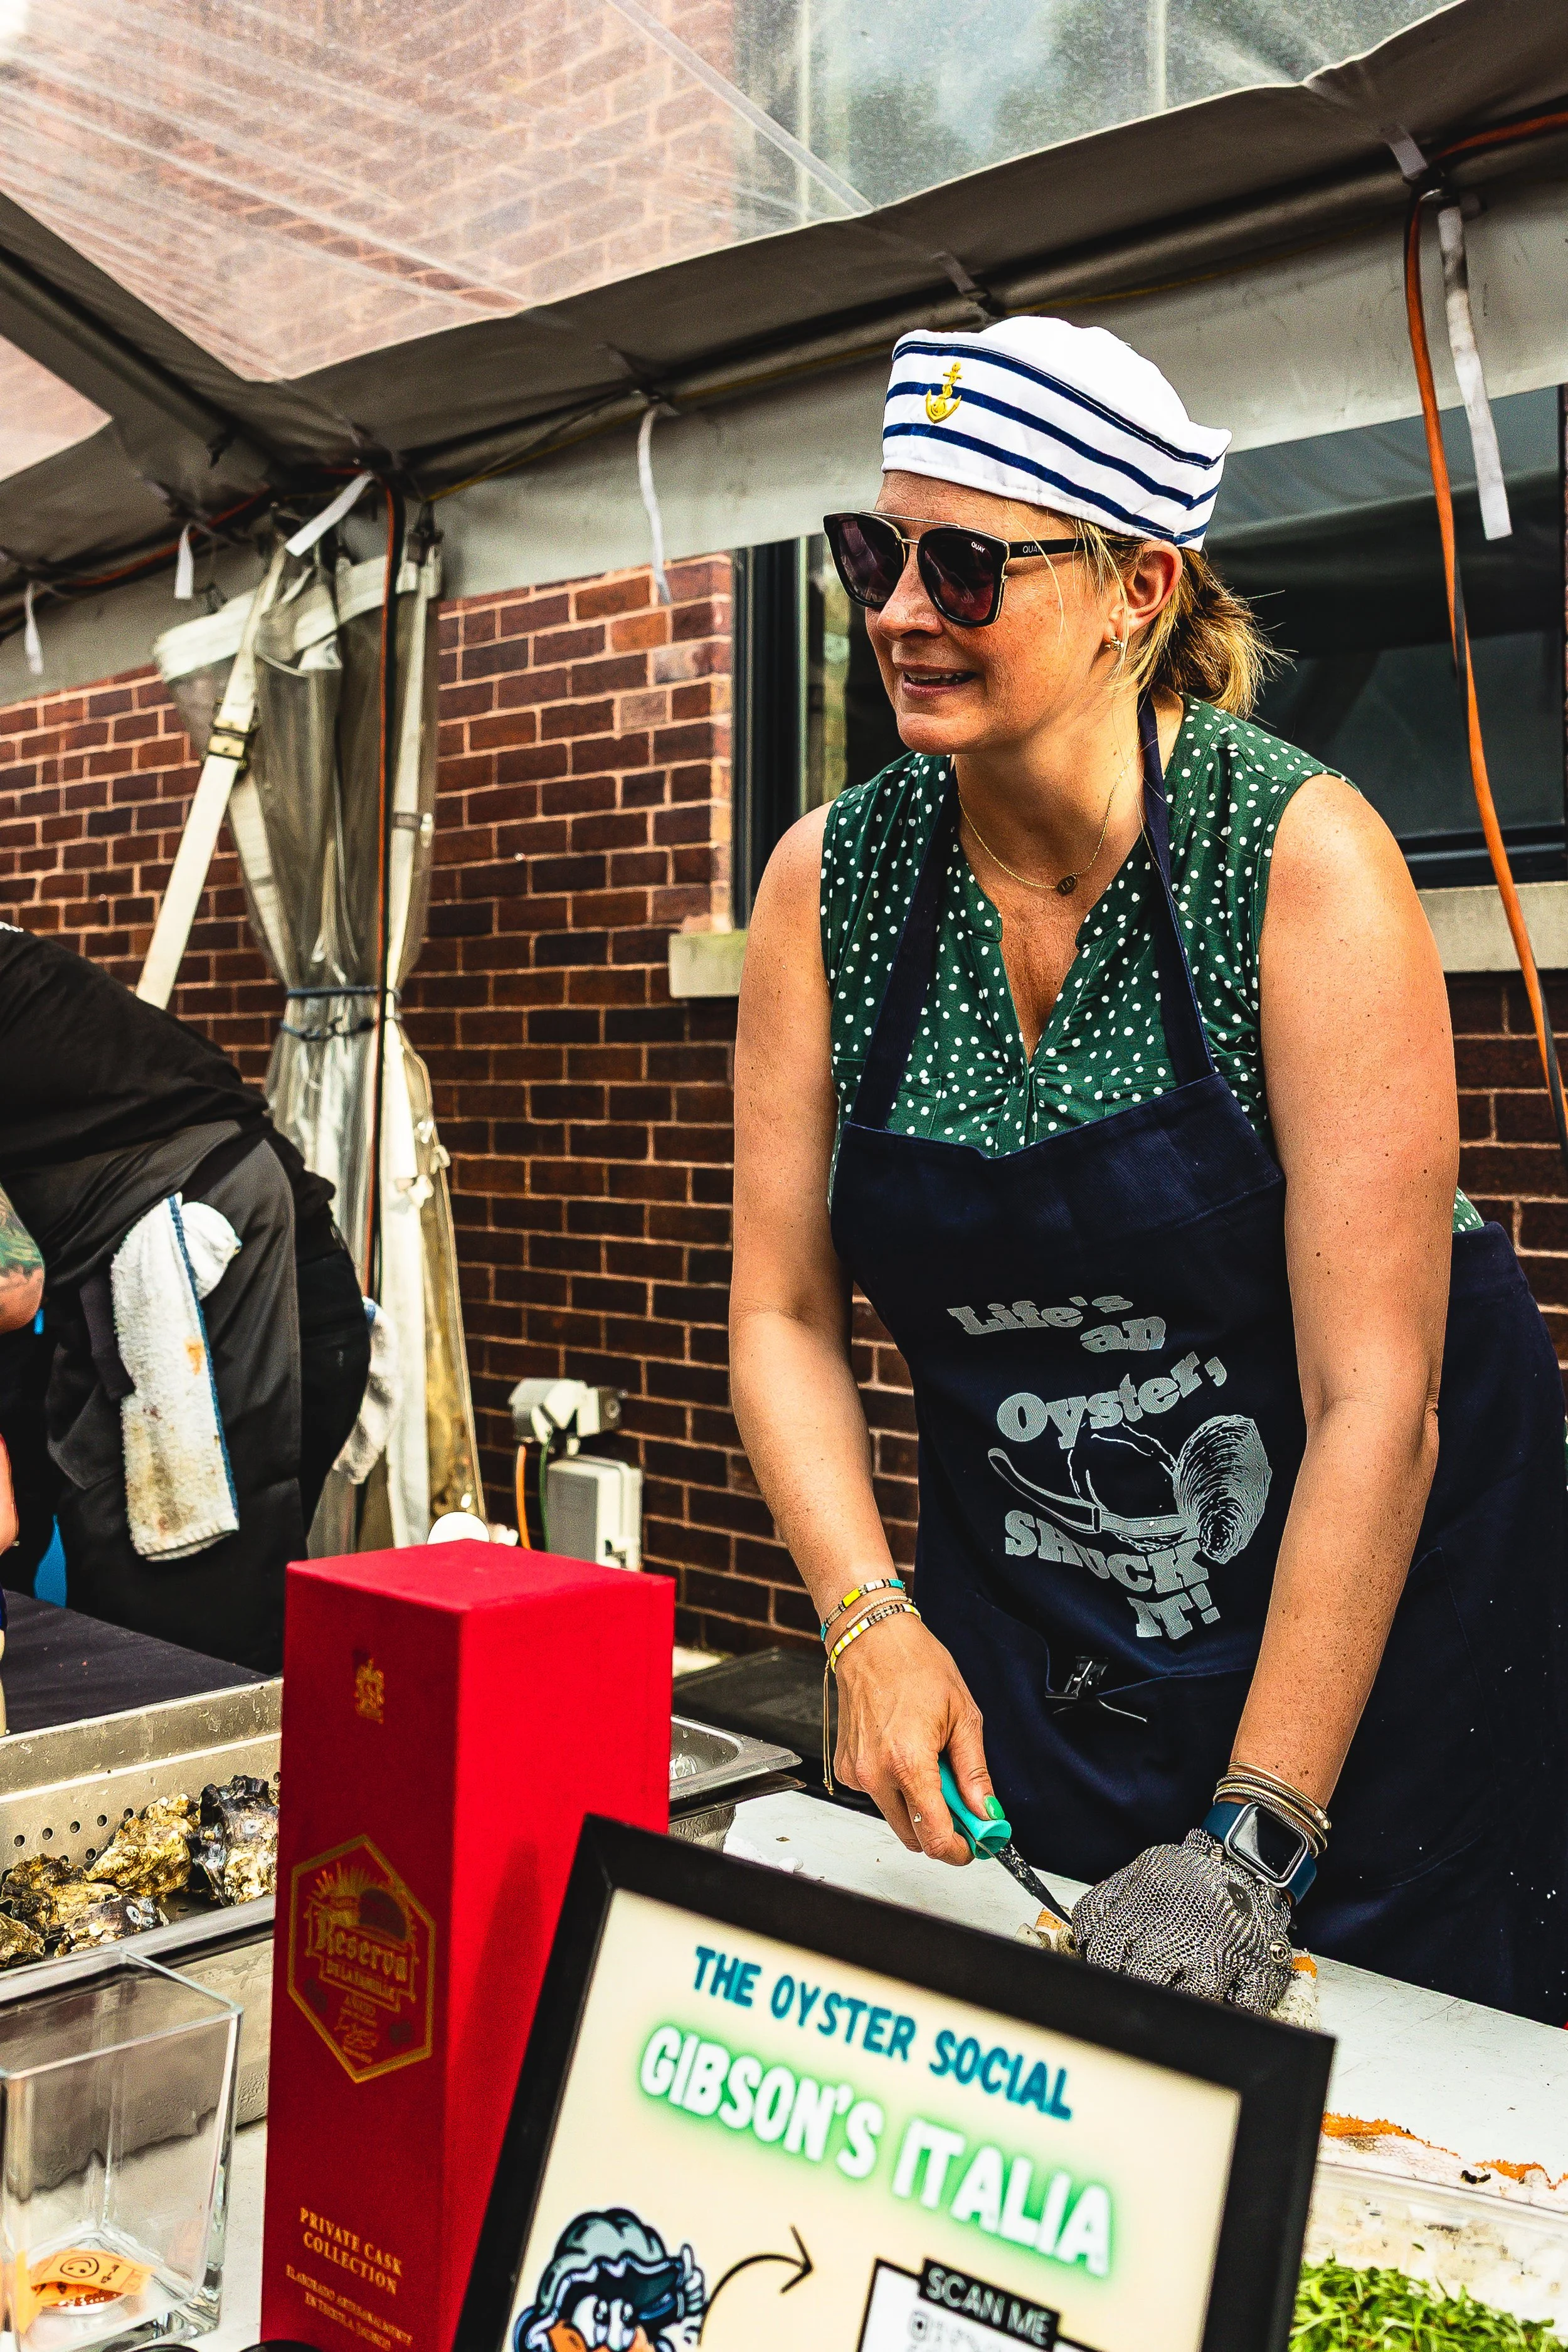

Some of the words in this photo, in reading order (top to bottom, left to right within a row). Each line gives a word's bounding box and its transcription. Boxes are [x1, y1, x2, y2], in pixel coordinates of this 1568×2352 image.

[971, 542, 985, 553] QUAY
[946, 1296, 1133, 1335] Life's
[1080, 1316, 1167, 1352] an
[997, 1351, 1227, 1449] Oyster,
[1005, 1510, 1209, 1594] SHUCK
[1127, 1583, 1221, 1640] IT!
[694, 1945, 762, 2007] THE
[771, 1974, 916, 2062] OYSTER
[929, 2030, 1073, 2121] SOCIAL
[640, 2026, 885, 2178] GIBSON'S
[893, 2119, 1112, 2276] ITALIA
[300, 2206, 360, 2253] PRIVATE
[364, 2242, 402, 2277] CASK
[303, 2231, 398, 2296] COLLECTION
[926, 2267, 1005, 2325] SCAN
[1006, 2301, 1050, 2346] ME
